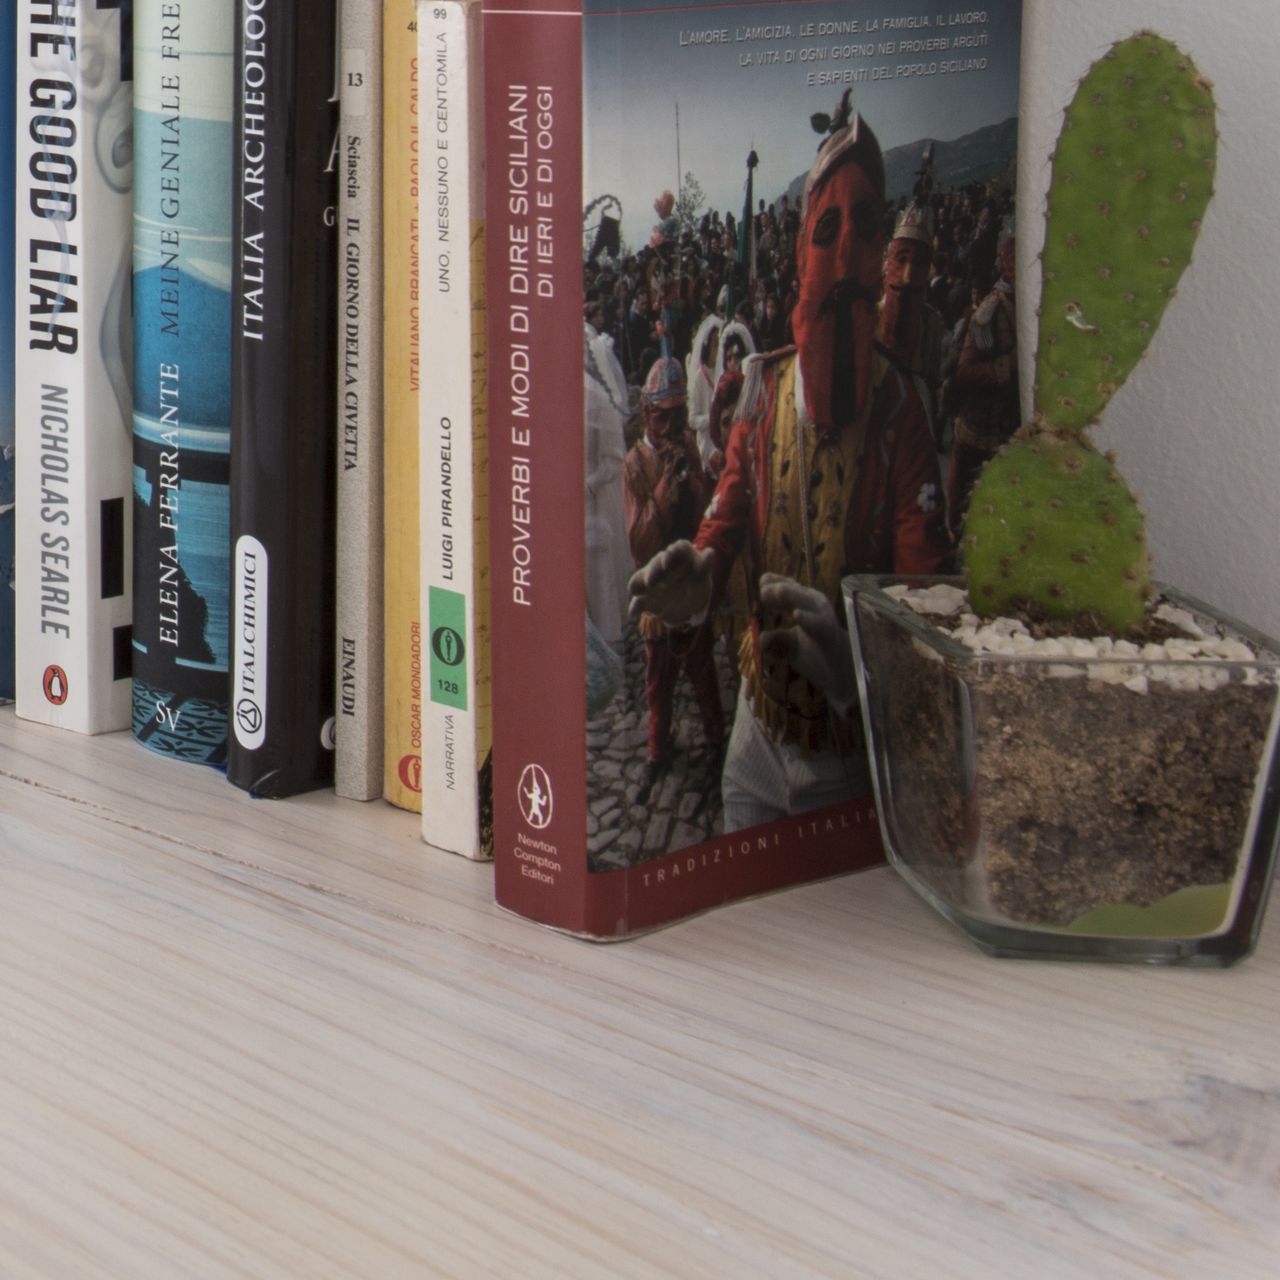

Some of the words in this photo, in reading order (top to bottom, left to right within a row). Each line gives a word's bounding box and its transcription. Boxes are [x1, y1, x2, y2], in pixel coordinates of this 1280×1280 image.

[433, 8, 448, 20] 99
[800, 22, 815, 37] LE
[865, 18, 880, 32] LA
[347, 73, 363, 87] 13
[436, 32, 448, 133] CENTOMILA
[740, 52, 754, 67] LA
[758, 50, 780, 65] VITA
[785, 49, 797, 63] DI
[799, 47, 828, 62] OGNI
[831, 42, 875, 60] GIORNO
[878, 40, 897, 56] NEI
[899, 36, 950, 54] PROVERBI
[806, 72, 815, 86] E
[817, 68, 869, 86] SAPIENTI
[872, 65, 893, 81] DEL
[895, 61, 937, 79] POPOLO
[940, 57, 988, 74] SICILIANO
[29, 77, 78, 222] GOOD
[160, 75, 180, 218] GENIALE
[437, 140, 449, 150] E
[537, 85, 553, 150] OGGI
[347, 135, 360, 199] Sciascia
[508, 84, 528, 216] SICILIANI
[537, 158, 553, 183] DI
[347, 218, 360, 237] IL
[437, 156, 449, 242] NESSUNO
[537, 192, 553, 208] E
[438, 250, 451, 293] UNO,
[509, 224, 529, 294] DIRE
[537, 216, 553, 264] IERI
[29, 238, 79, 355] LIAR
[160, 230, 180, 337] MEINE
[243, 231, 265, 342] ITALIA
[346, 242, 360, 319] GIORNO
[537, 272, 554, 298] DI
[510, 304, 529, 333] DI
[345, 322, 359, 386] DELLA
[510, 343, 530, 418] MODI
[40, 383, 69, 526] NICHOLAS
[160, 362, 180, 531] FERRANTE
[344, 390, 359, 471] CIVETTA
[511, 427, 531, 447] E
[440, 416, 453, 528] PIRANDELLO
[442, 531, 453, 581] LUIGI
[512, 456, 531, 606] PROVERBI
[40, 532, 70, 639] SEARLE
[160, 544, 179, 647] ELENA
[242, 552, 257, 695] ITALCHIMICI
[342, 637, 356, 717] EINAUDI
[410, 622, 421, 701] MONDADORI
[438, 679, 459, 695] 128
[410, 703, 422, 748] OSCAR
[445, 714, 456, 790] NARRATIVA
[513, 847, 561, 872] Compton
[518, 833, 557, 855] Newton
[521, 864, 554, 885] Editori
[643, 832, 780, 887] TRADIZIONI
